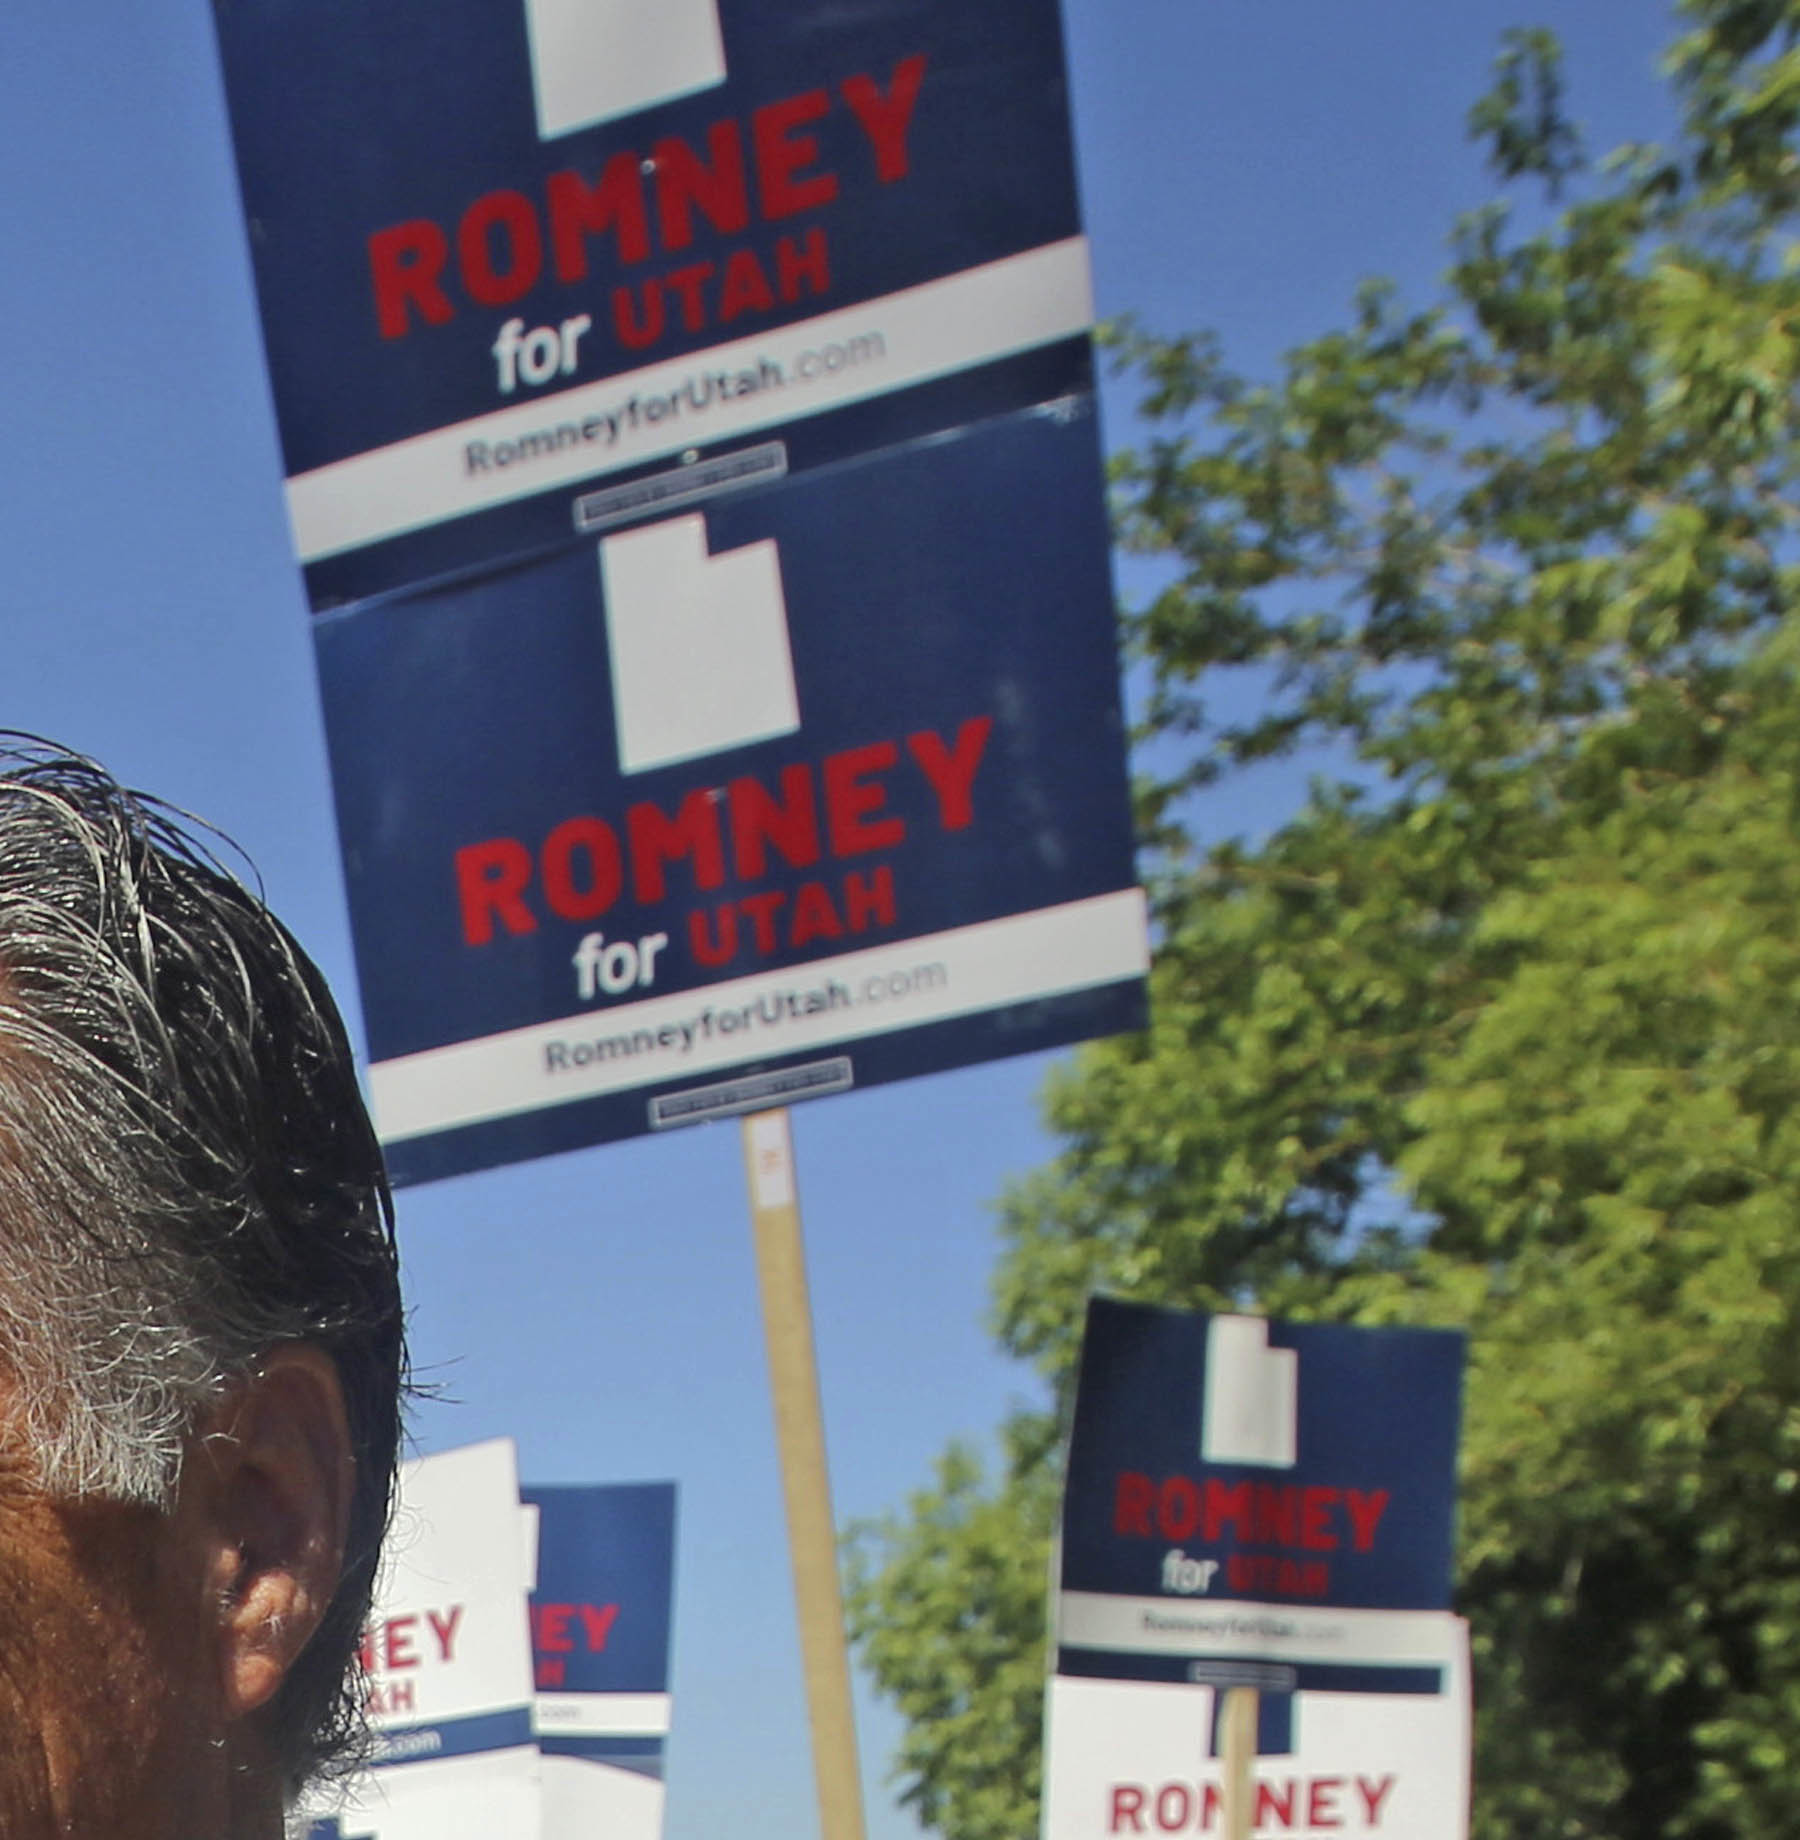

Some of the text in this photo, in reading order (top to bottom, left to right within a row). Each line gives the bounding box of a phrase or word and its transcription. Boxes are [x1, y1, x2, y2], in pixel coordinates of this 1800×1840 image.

[367, 53, 930, 343] ROMNEY
[492, 226, 834, 394] for UTAH
[465, 326, 886, 480] RomneyforUtah.com
[452, 715, 994, 949] ROMNEY
[573, 864, 900, 1000] for UTAH
[544, 956, 950, 1078] RomneyforUtah.com
[1113, 1470, 1391, 1552] ROMNEY
[1161, 1548, 1219, 1593] for
